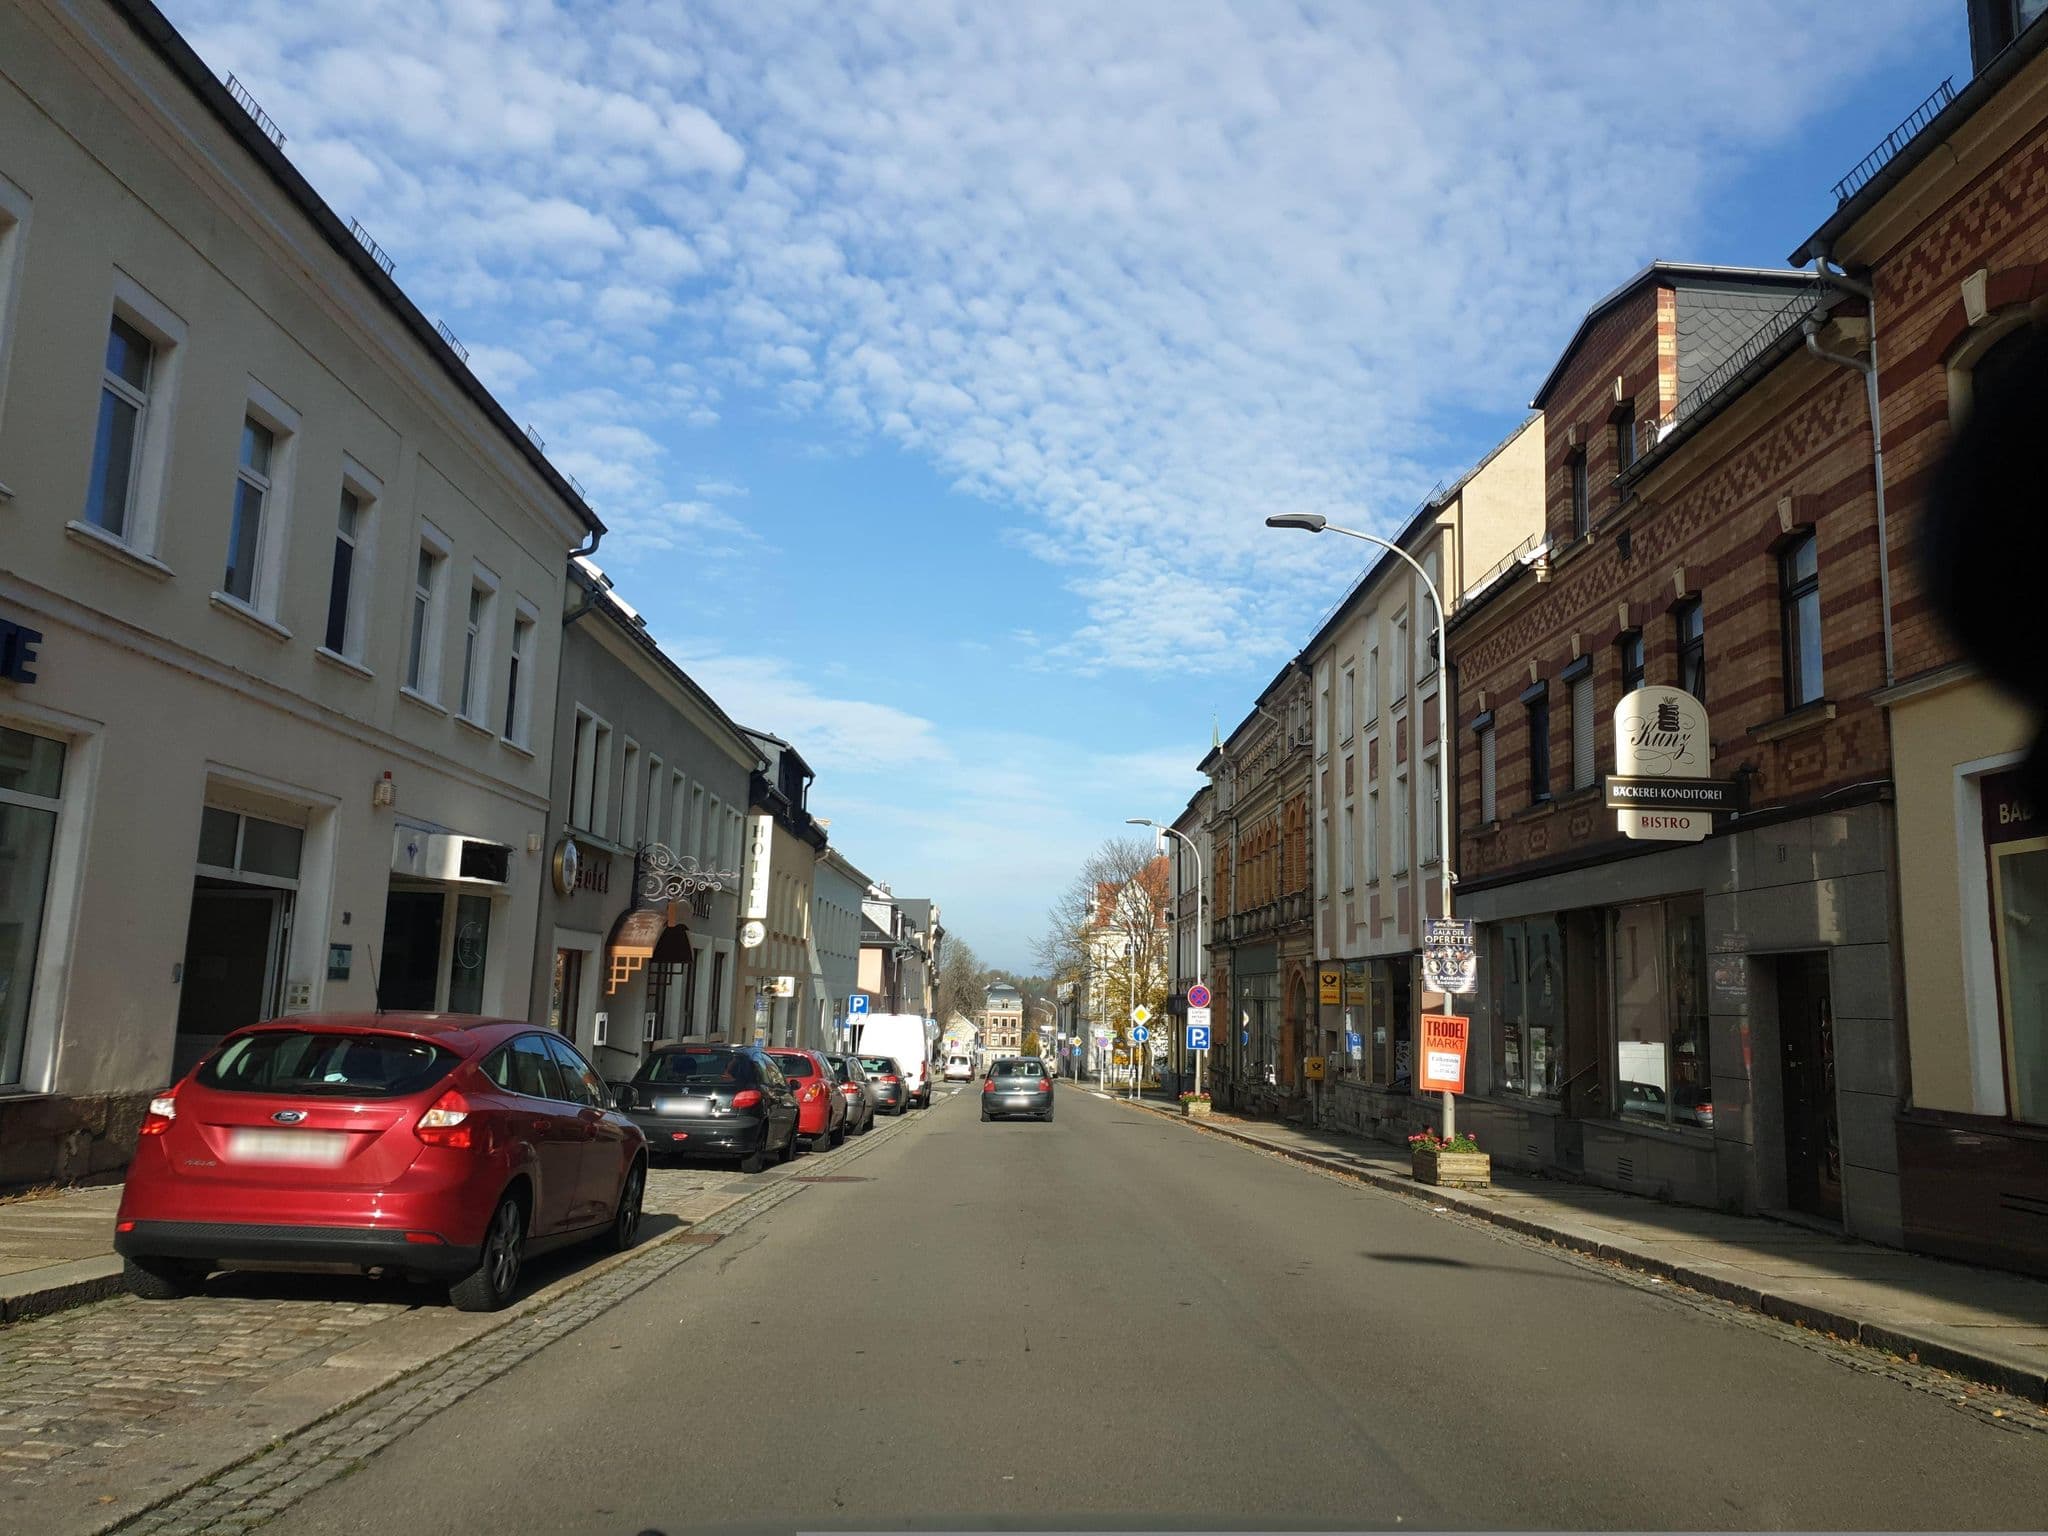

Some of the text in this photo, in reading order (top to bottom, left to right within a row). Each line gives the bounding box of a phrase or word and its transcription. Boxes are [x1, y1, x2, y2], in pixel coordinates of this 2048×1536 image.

[1630, 715, 1691, 760] Kunz
[1613, 785, 1722, 800] BÄCKEREI KONDITOREI
[1641, 816, 1690, 829] BISTRO
[750, 824, 765, 908] HOTEL
[1424, 935, 1474, 944] OPERETTE
[854, 998, 864, 1012] P
[1426, 1020, 1465, 1039] TRÖDEL
[1192, 1029, 1204, 1046] P
[1426, 1037, 1465, 1050] MARKT
